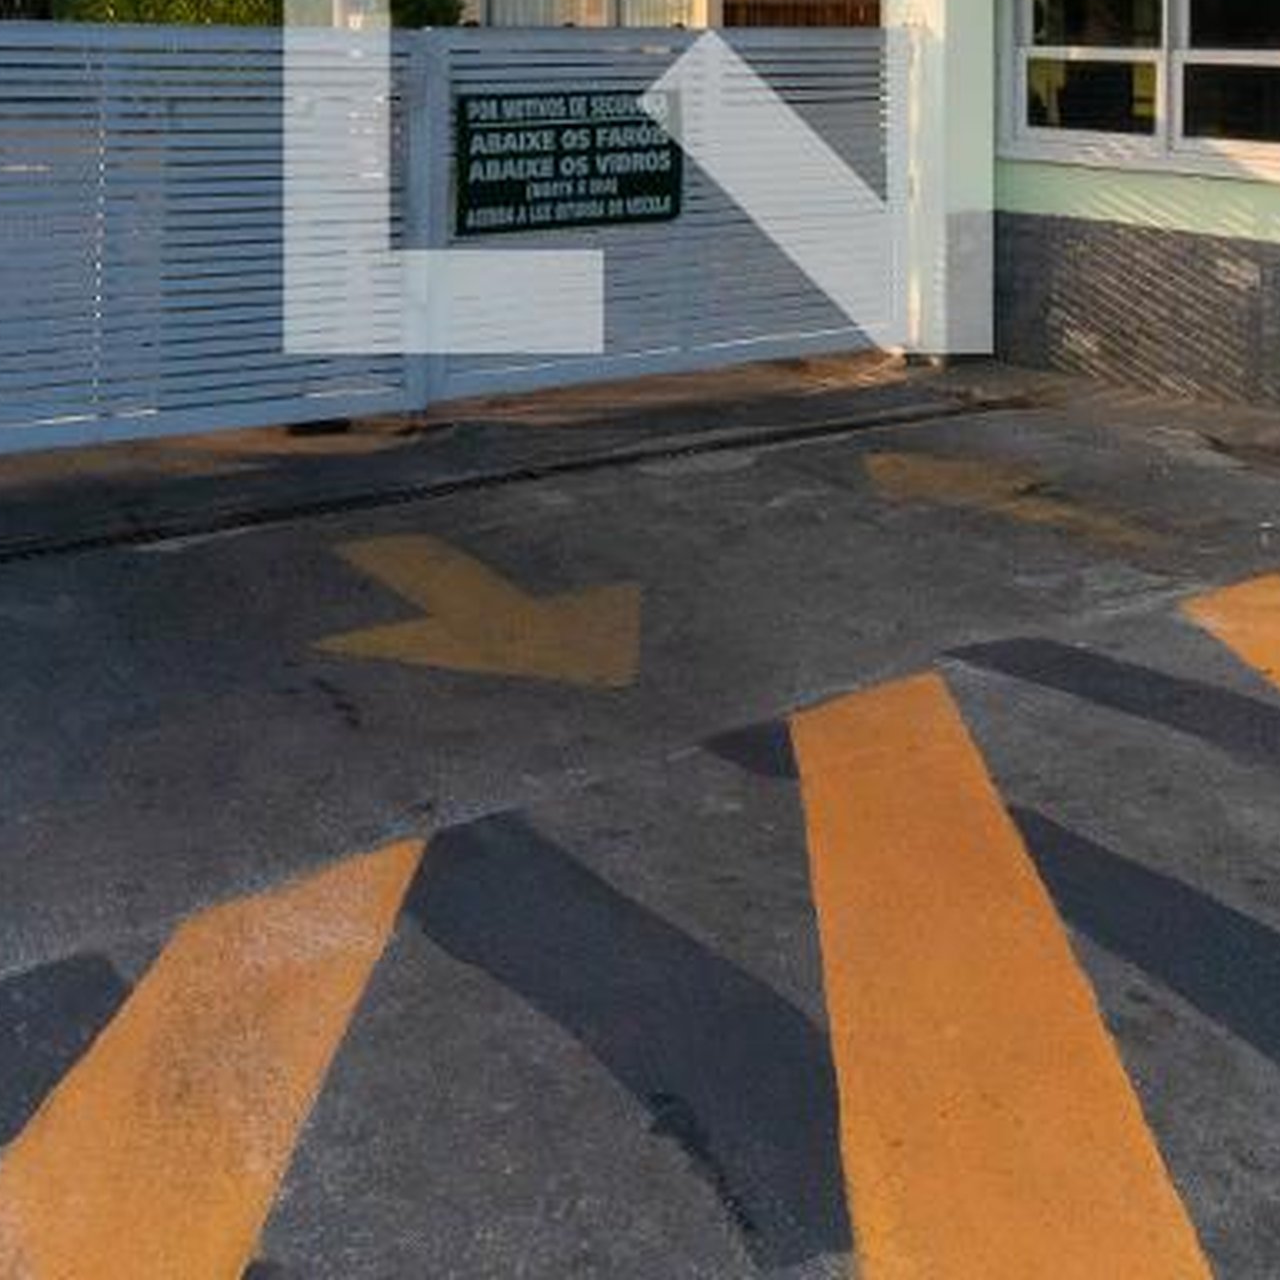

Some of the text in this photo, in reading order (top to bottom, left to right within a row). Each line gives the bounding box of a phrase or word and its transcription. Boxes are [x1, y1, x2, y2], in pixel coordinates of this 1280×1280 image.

[470, 130, 557, 154] ABAIXE
[561, 129, 590, 149] OS
[469, 150, 671, 181] ABAIXE OS VIDROS
